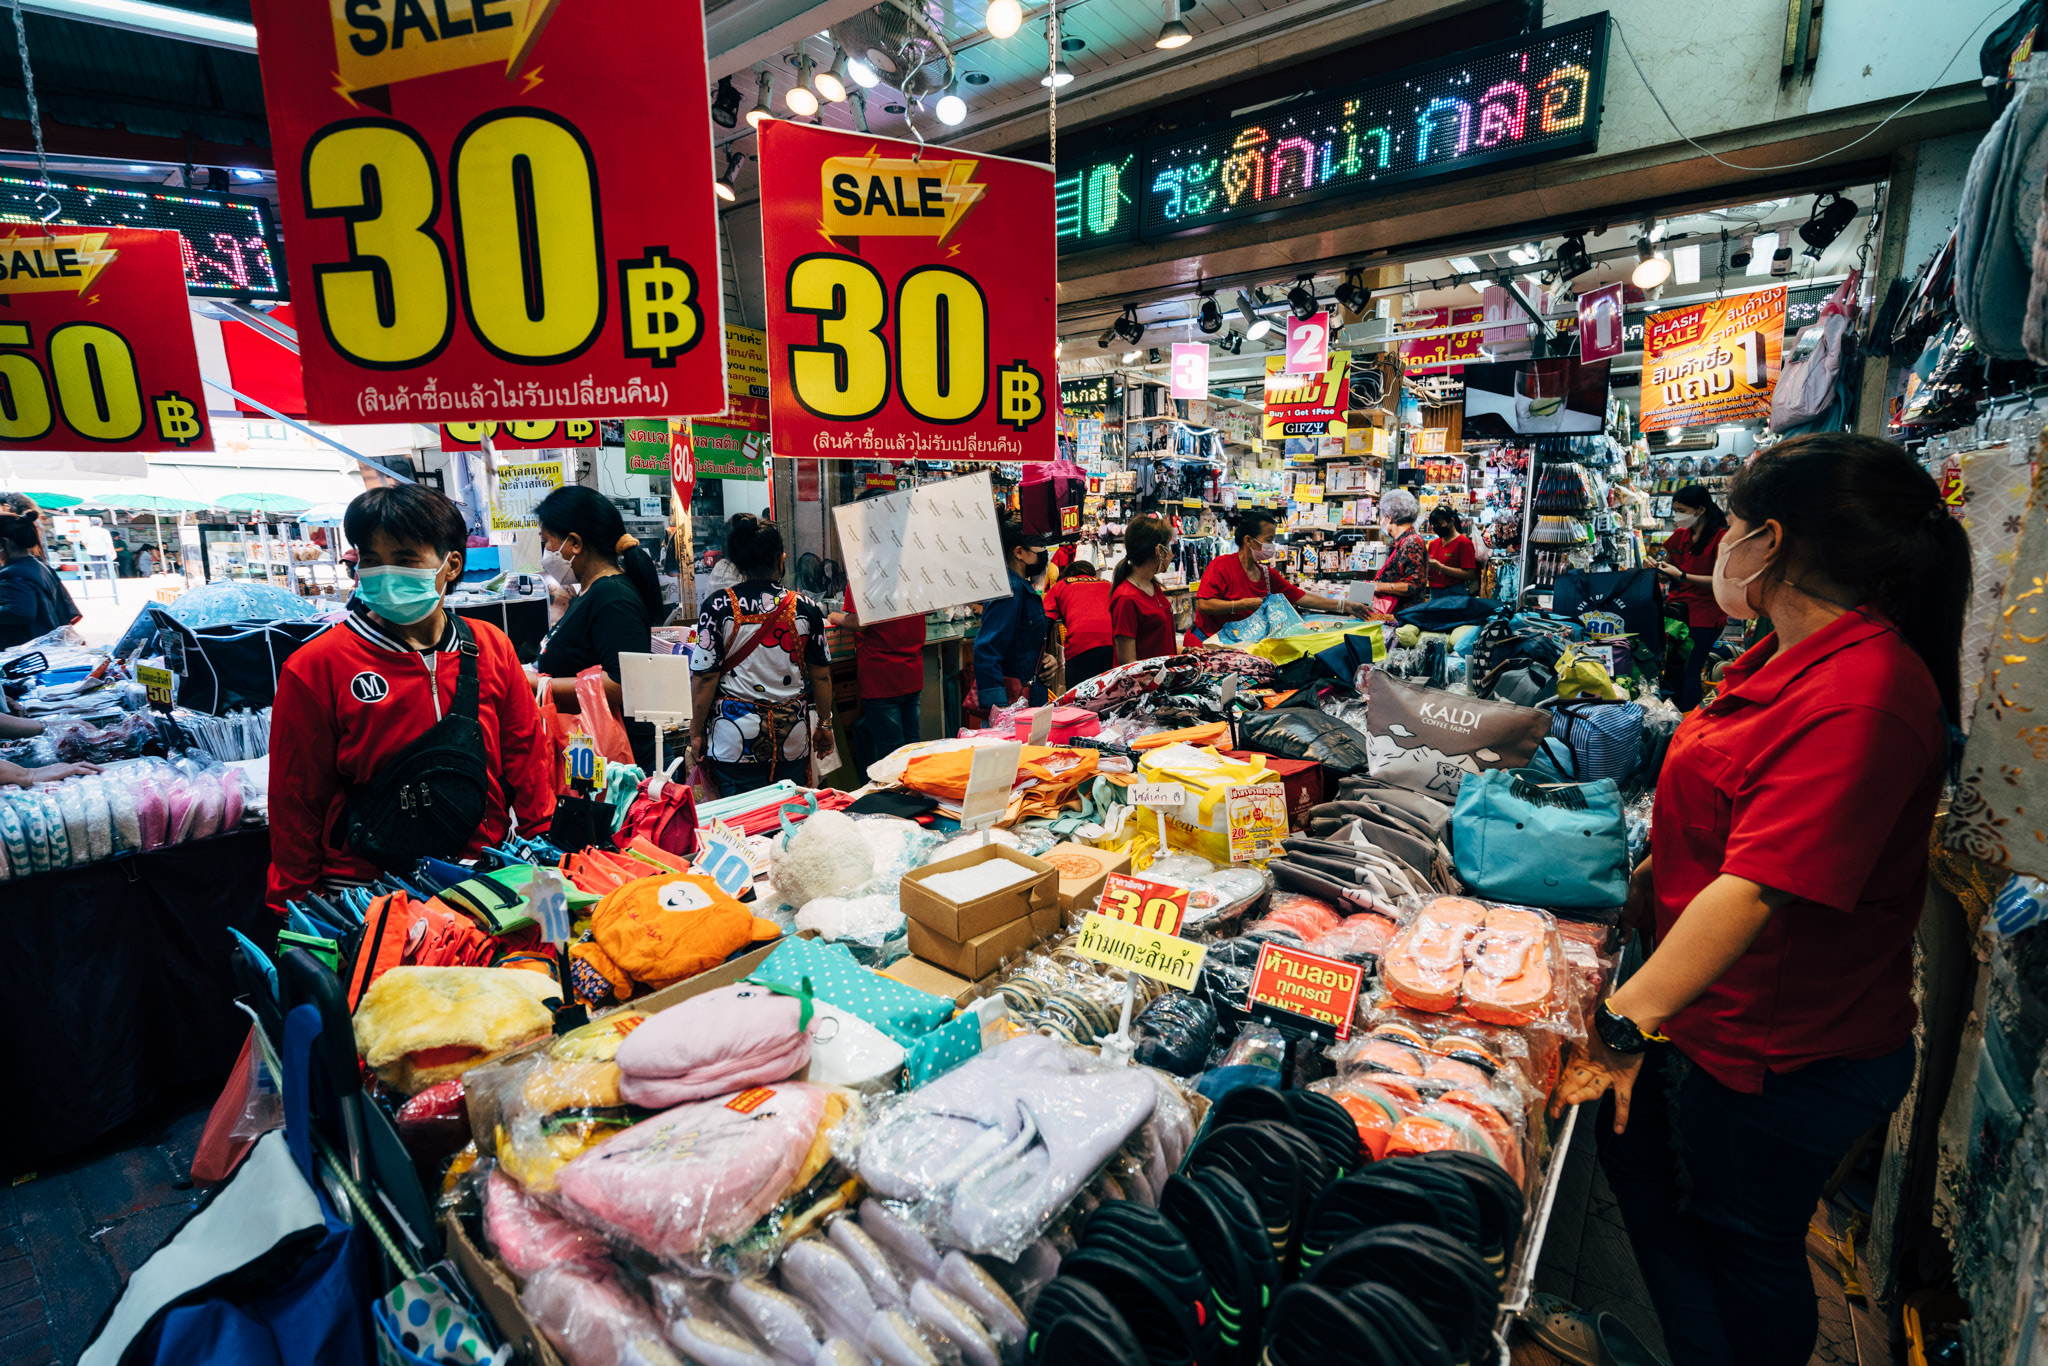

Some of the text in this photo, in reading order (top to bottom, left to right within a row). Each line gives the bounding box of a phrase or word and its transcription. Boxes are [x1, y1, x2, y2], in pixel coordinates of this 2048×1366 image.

[345, 0, 514, 56] SALE
[832, 173, 945, 218] SALE
[302, 106, 609, 371] 30
[0, 248, 82, 280] ALE
[786, 252, 990, 425] 30
[1652, 325, 1699, 350] SALE
[1653, 313, 1699, 337] FLASH
[1291, 323, 1324, 364] 2
[727, 361, 745, 370] you
[1175, 353, 1205, 390] 3
[1662, 369, 1735, 406] แถม
[1269, 410, 1284, 418] Buy
[674, 443, 689, 483] 80
[1063, 512, 1078, 528] 40
[148, 685, 170, 703] 50
[357, 675, 382, 700] M
[1419, 702, 1482, 729] KALDI
[1422, 718, 1471, 735] COFFEE FARM
[569, 748, 593, 779] 10
[701, 840, 750, 893] 10
[1105, 887, 1180, 937] 30
[1081, 922, 1195, 981] ห้ามแกะสินค้า
[1263, 950, 1354, 992] ห้ามลอง
[1276, 979, 1333, 1005] ทุกกรณี
